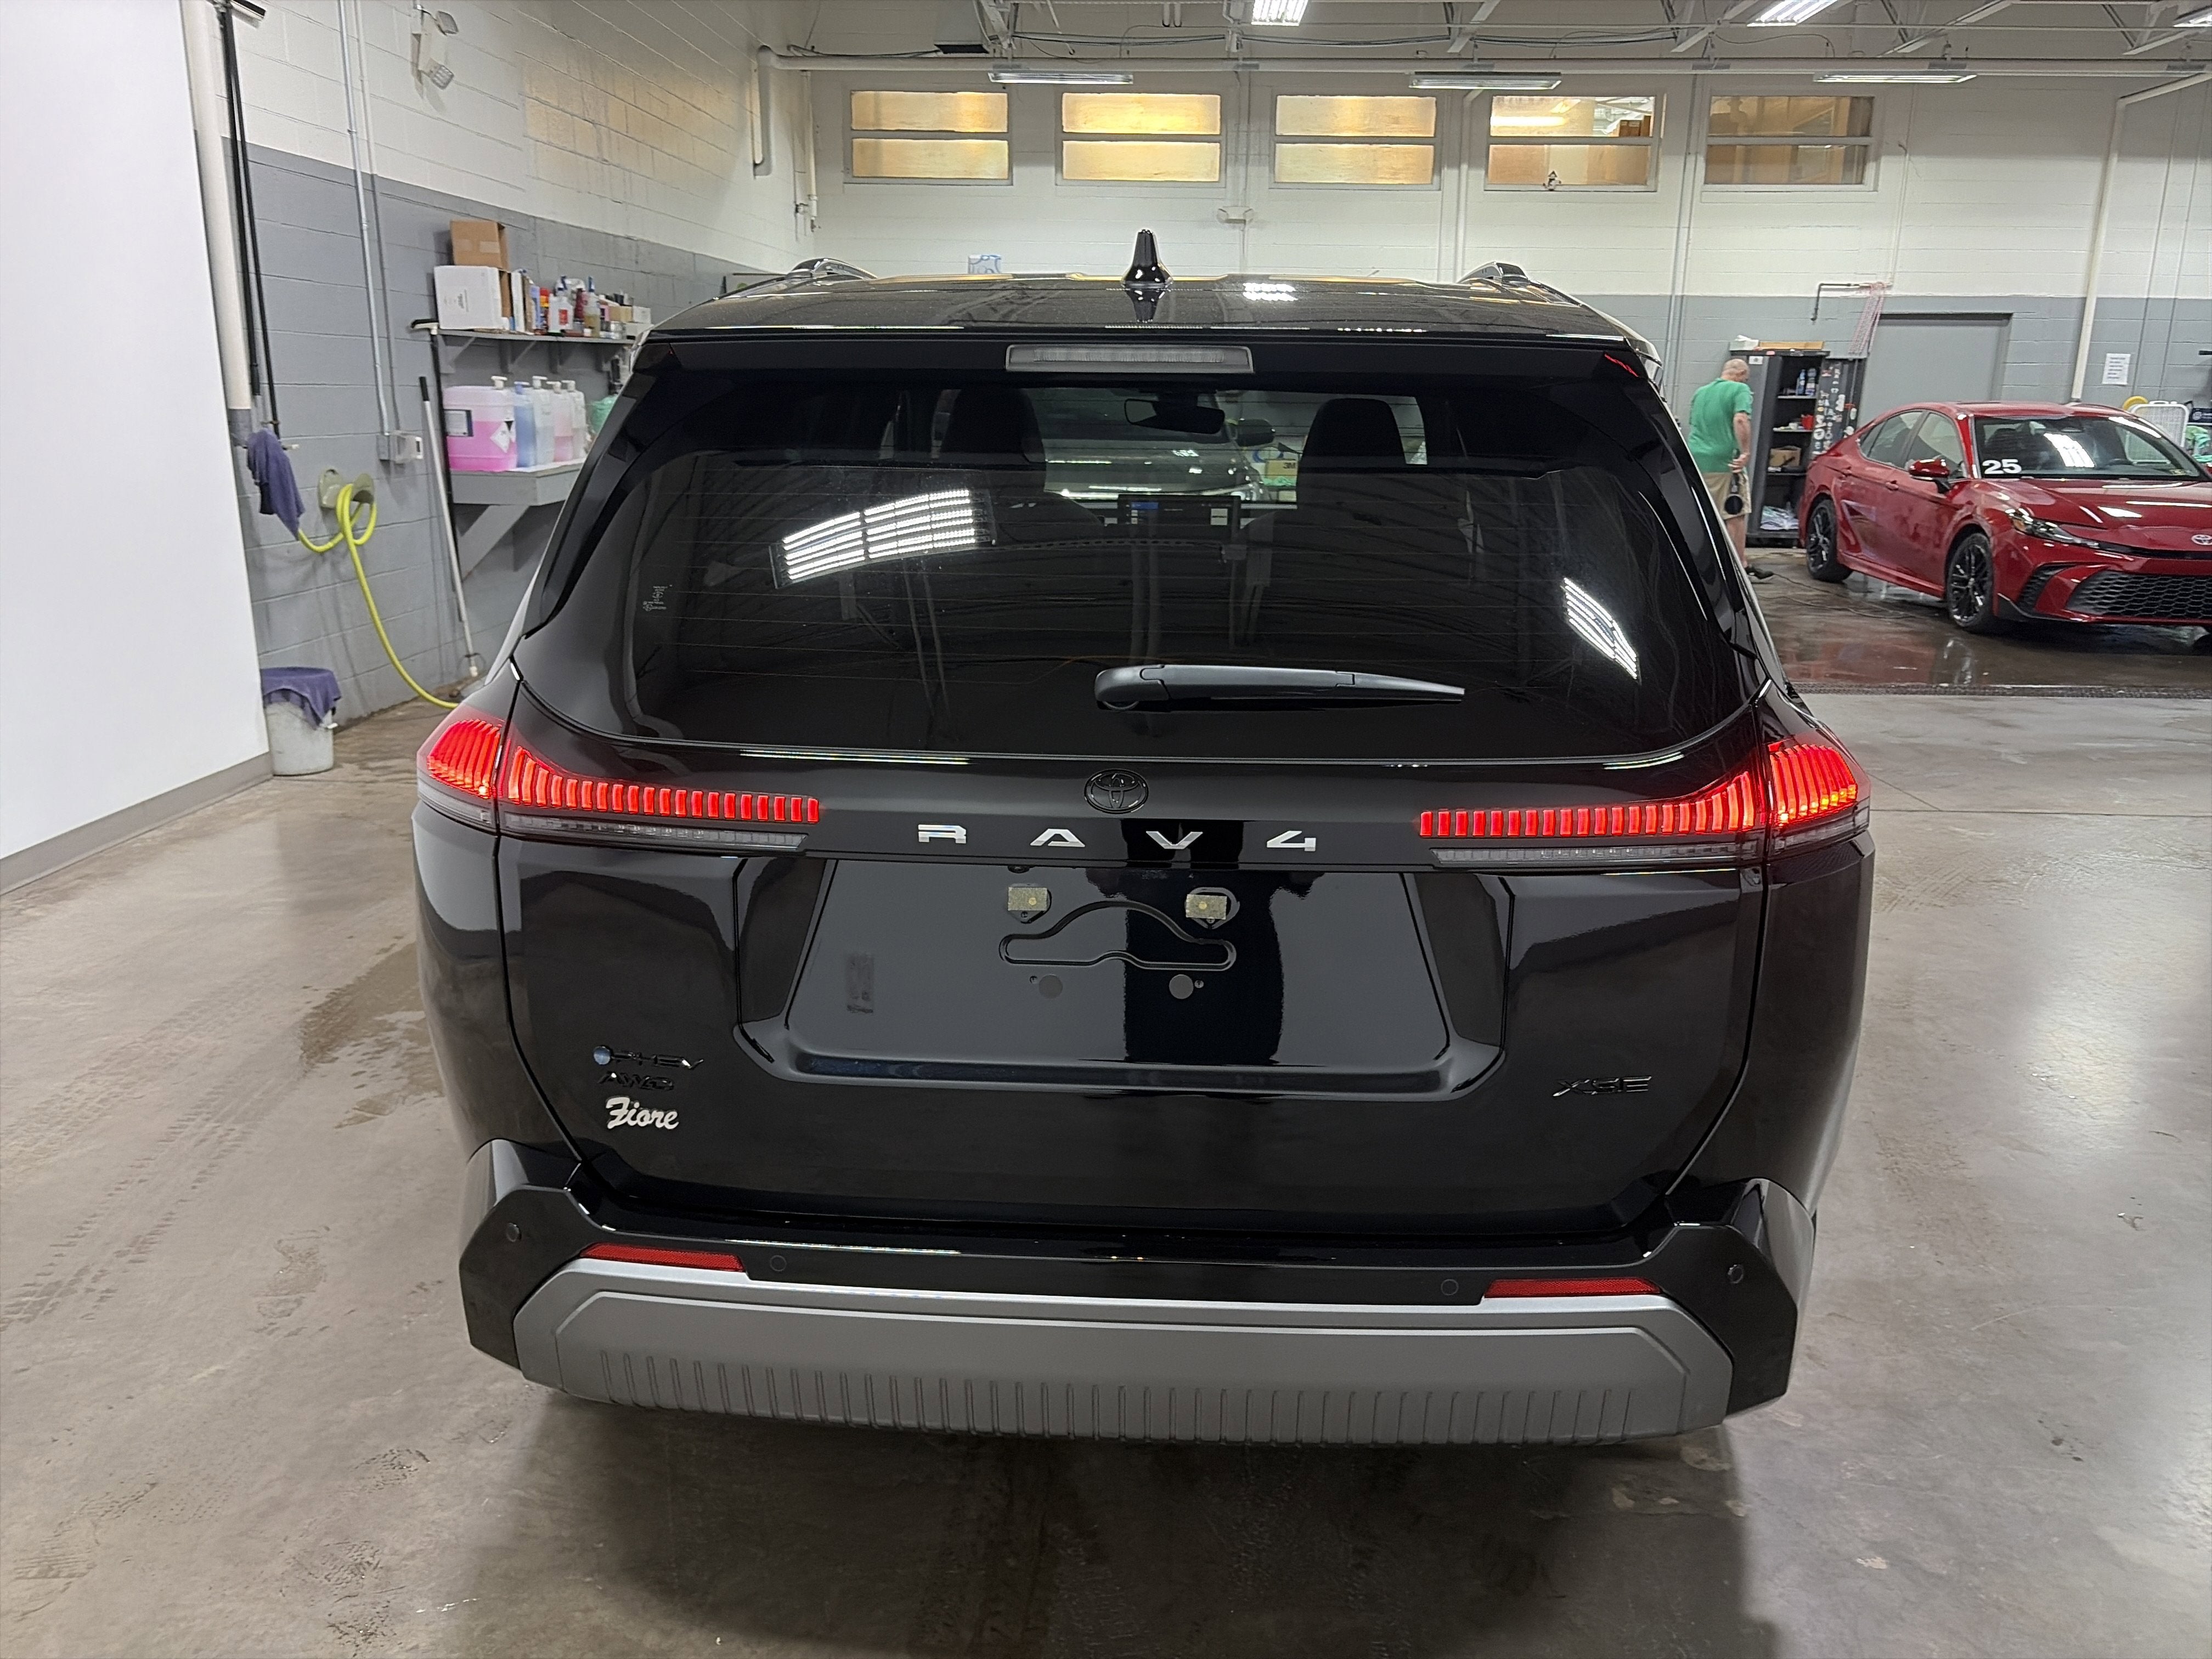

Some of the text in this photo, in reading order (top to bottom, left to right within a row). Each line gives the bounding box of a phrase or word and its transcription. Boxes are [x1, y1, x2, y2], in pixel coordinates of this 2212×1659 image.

[1982, 459, 2022, 475] 25
[918, 824, 1316, 852] RAV4
[1552, 1076, 1652, 1097] XSE
[605, 1096, 680, 1130] Fiore
